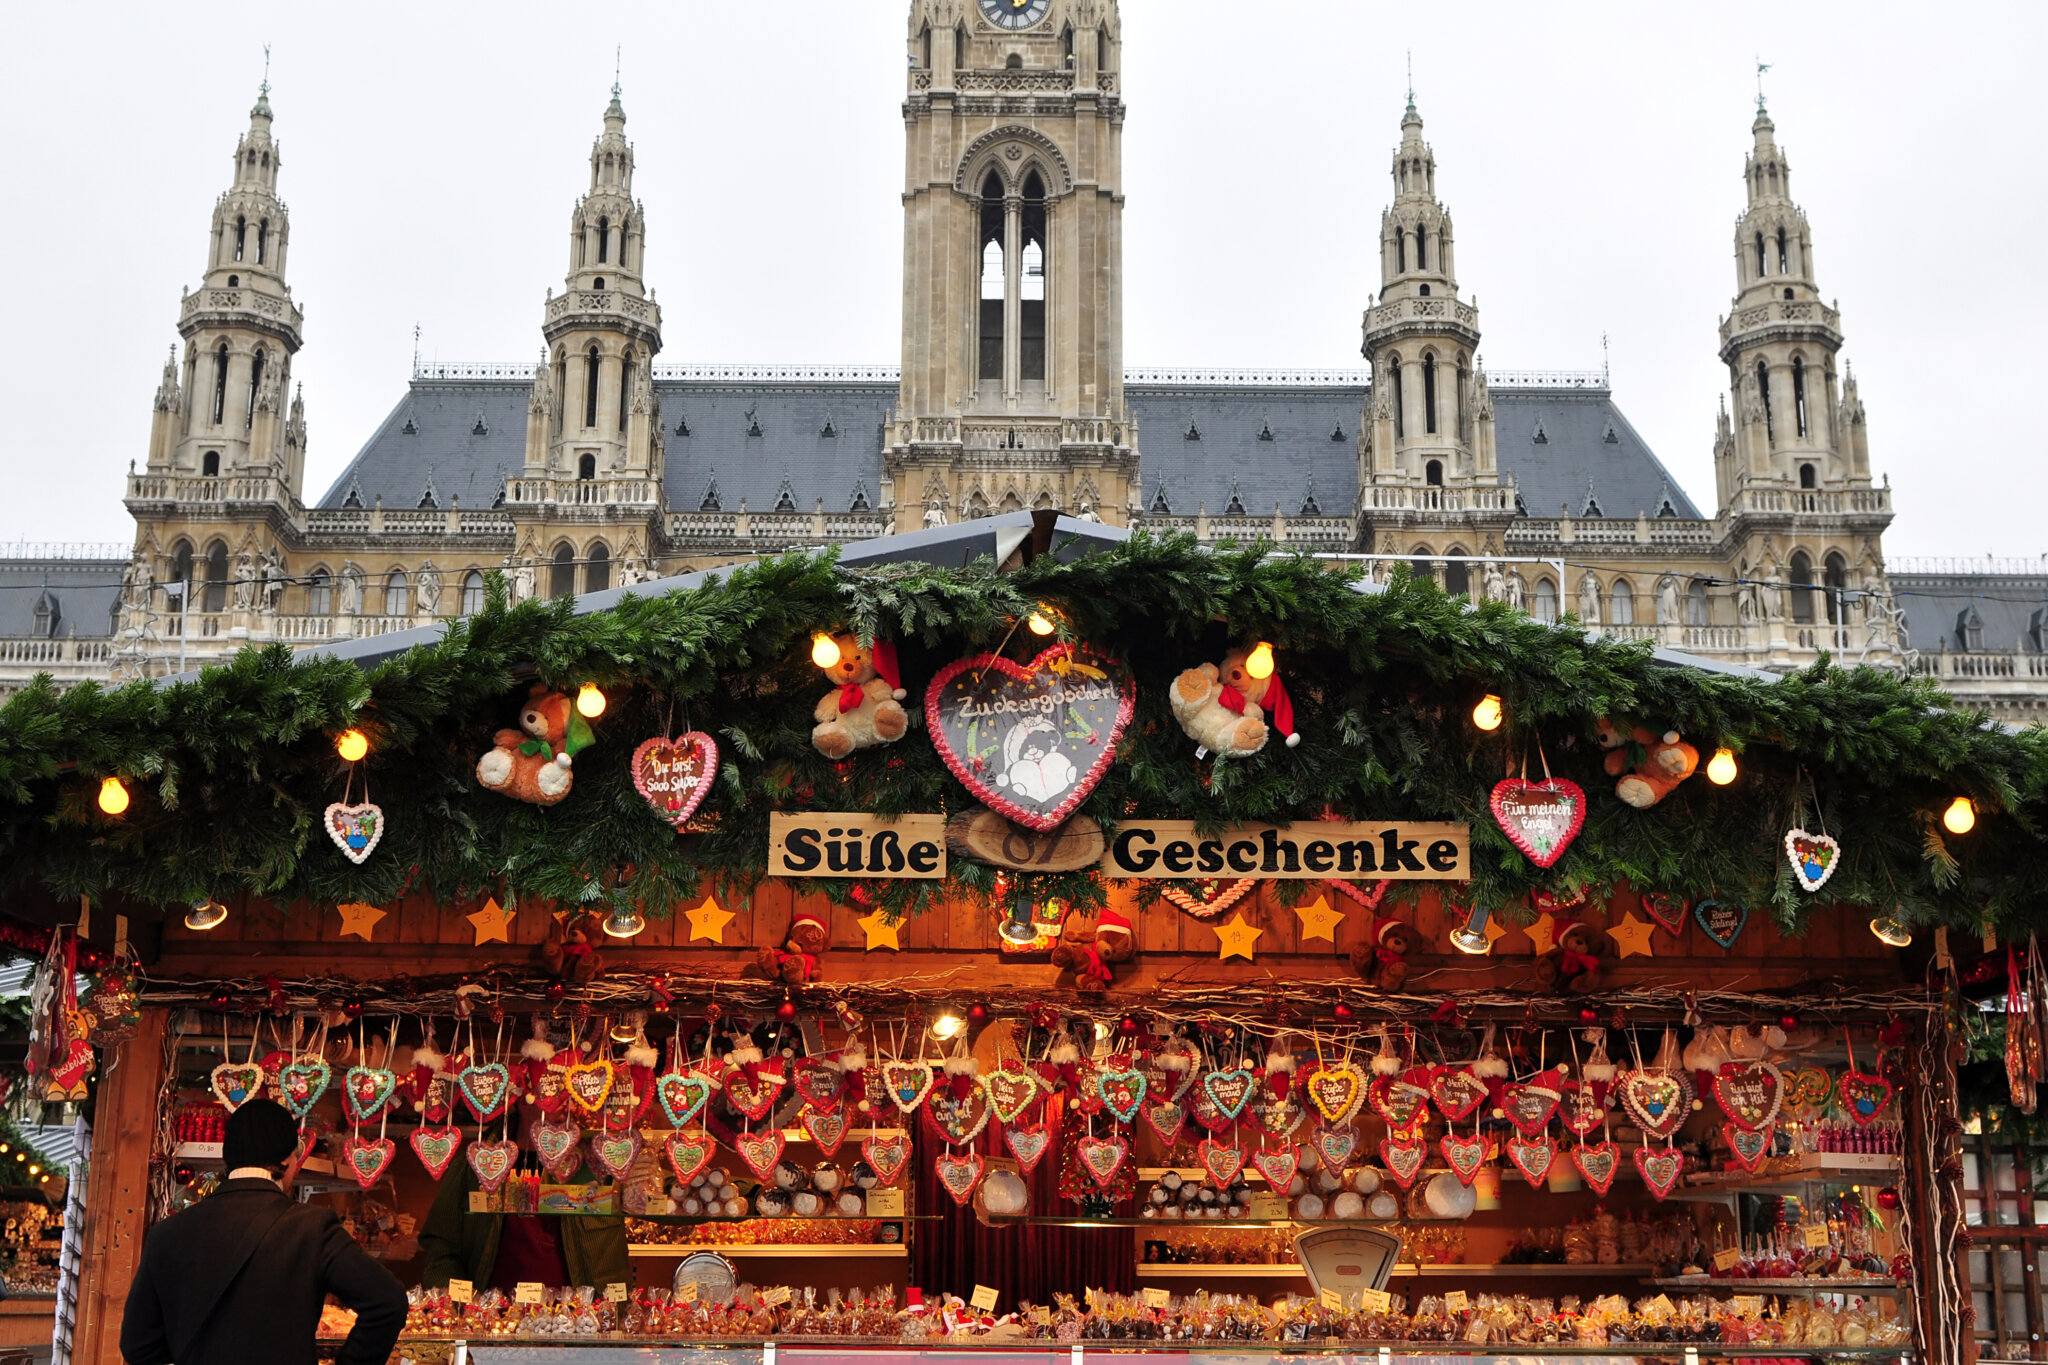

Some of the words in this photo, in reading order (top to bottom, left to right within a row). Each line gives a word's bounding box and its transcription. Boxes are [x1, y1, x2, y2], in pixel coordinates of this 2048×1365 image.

[652, 759, 669, 775] Du
[672, 755, 695, 773] bist
[1501, 801, 1526, 816] Für
[1529, 801, 1572, 816] meinen
[1521, 815, 1555, 834] Engel
[783, 827, 939, 873] Süße
[1112, 828, 1459, 873] Geschenke
[579, 1073, 600, 1086] Alles
[581, 1086, 603, 1097] Liebe
